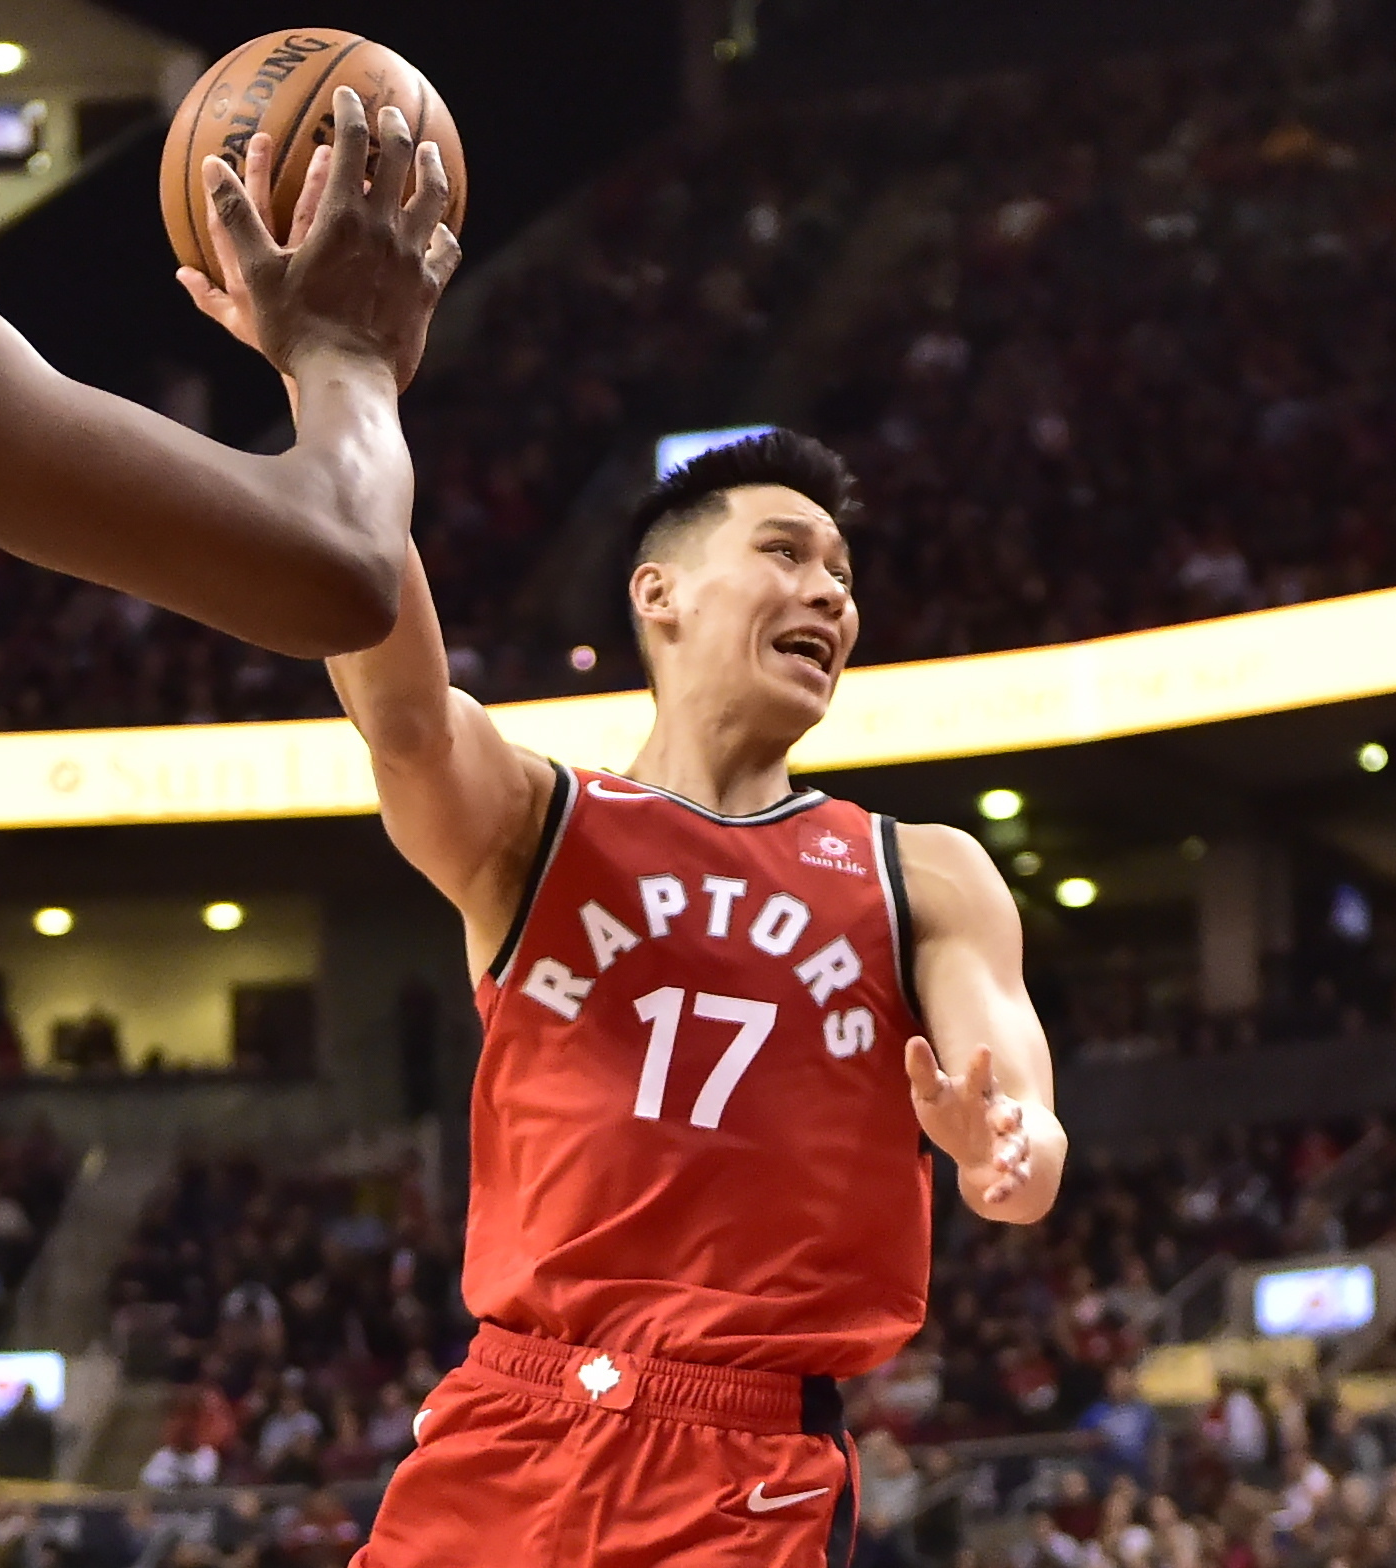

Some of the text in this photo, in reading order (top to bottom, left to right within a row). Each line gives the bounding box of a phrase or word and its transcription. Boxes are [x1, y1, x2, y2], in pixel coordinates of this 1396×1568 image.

[219, 35, 332, 184] PALDING
[521, 872, 876, 1059] RAPTORS
[633, 986, 778, 1129] 17
